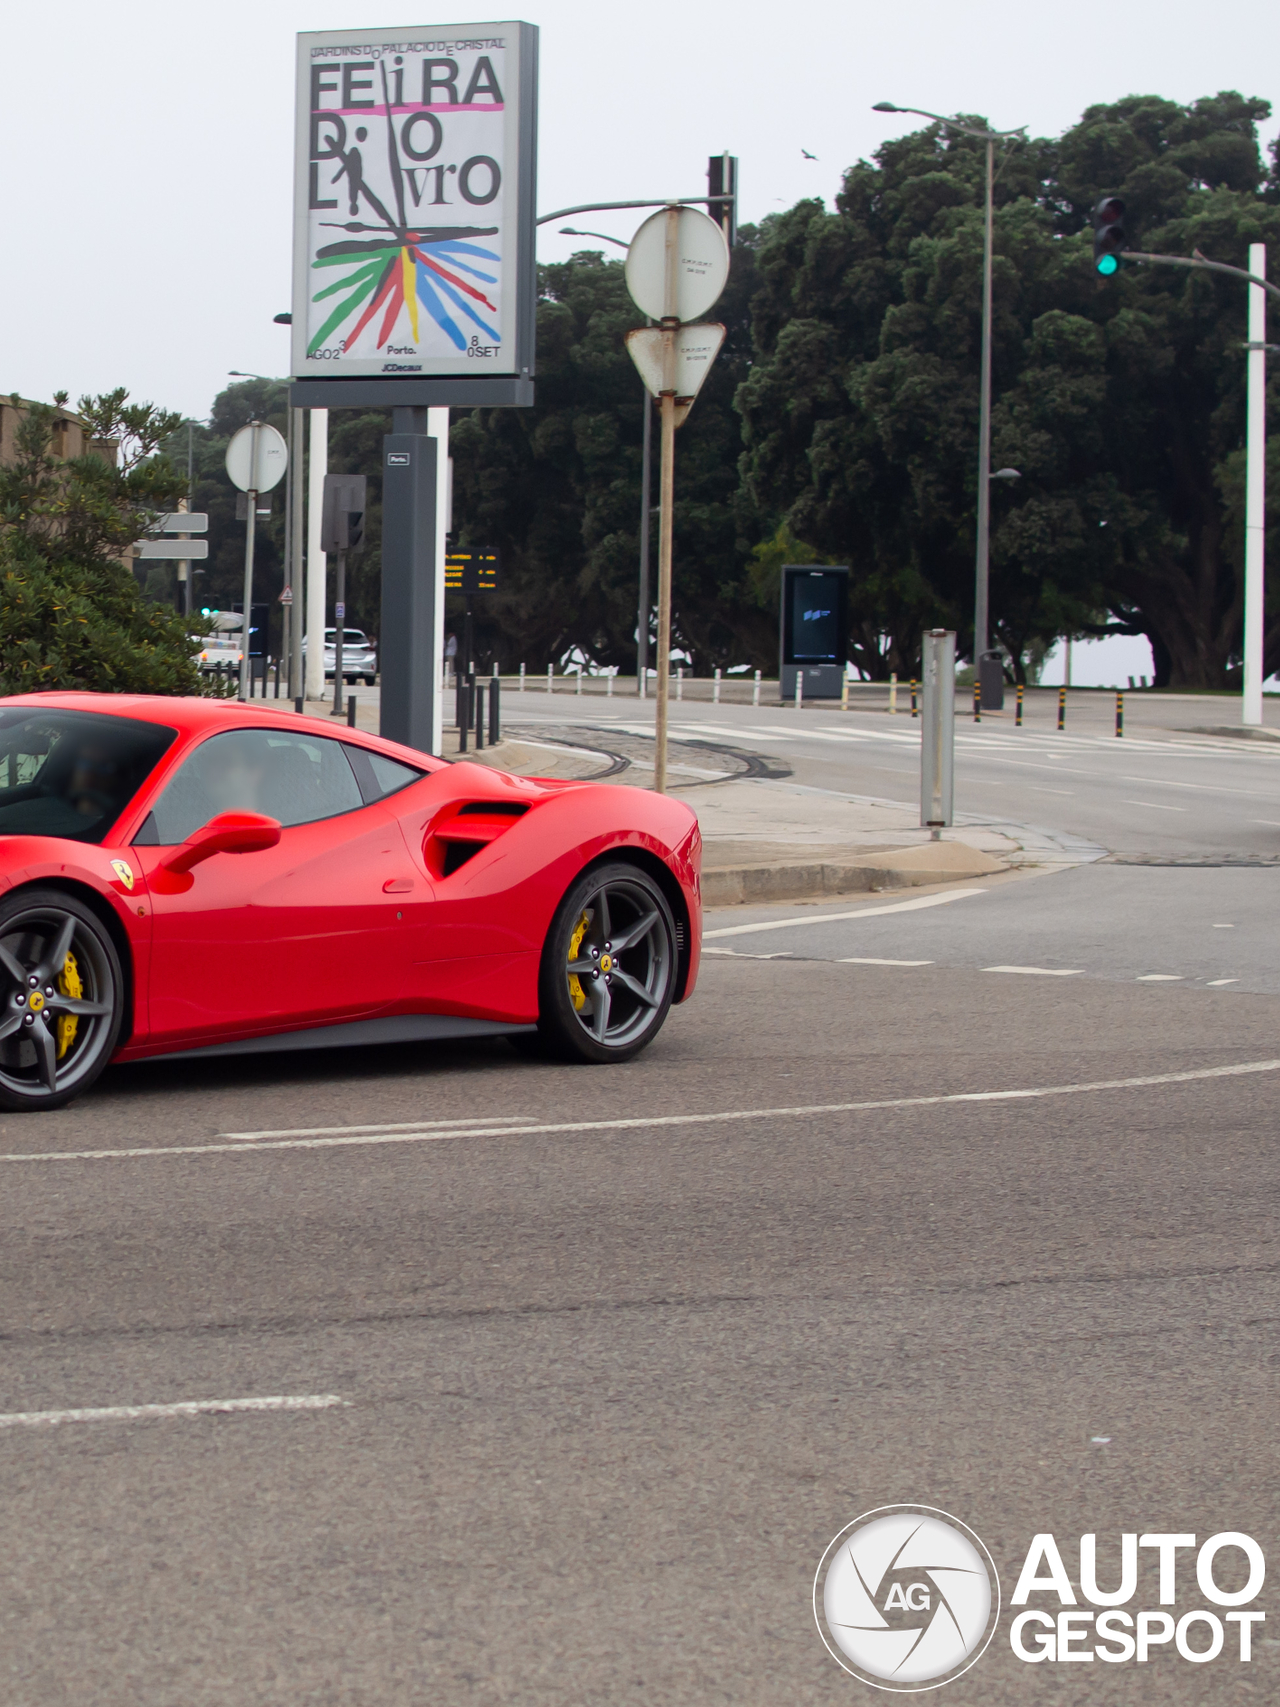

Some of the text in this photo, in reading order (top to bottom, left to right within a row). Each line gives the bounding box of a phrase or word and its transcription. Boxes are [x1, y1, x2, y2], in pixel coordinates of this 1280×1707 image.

[311, 47, 362, 57] JARDINS
[455, 38, 506, 50] CRISTAL
[381, 363, 423, 372] JCDecaux
